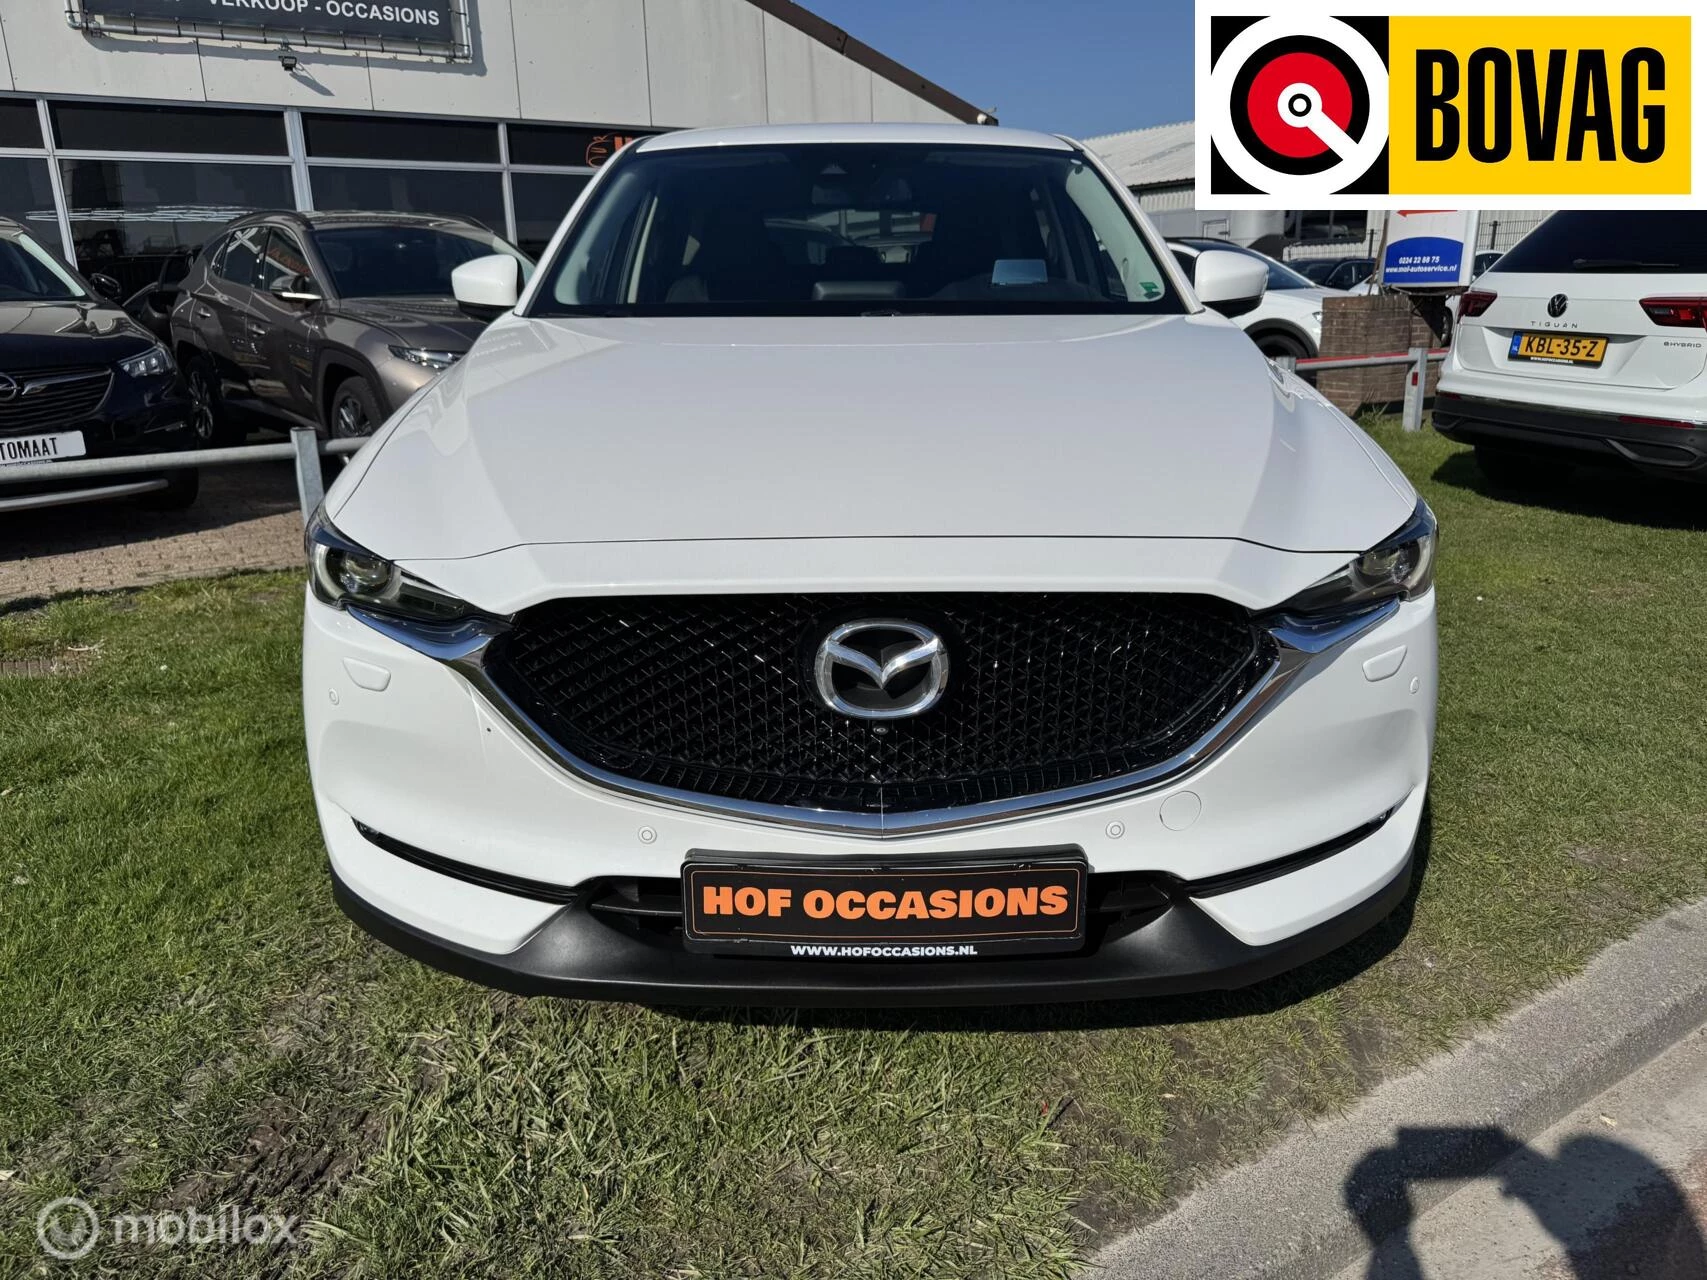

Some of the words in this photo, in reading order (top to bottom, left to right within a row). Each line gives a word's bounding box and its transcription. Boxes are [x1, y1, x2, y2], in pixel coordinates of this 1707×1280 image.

[327, 0, 440, 25] OCCASIONS
[1530, 320, 1578, 329] TIGUAN
[1524, 336, 1599, 357] KBL-35-Z
[0, 437, 58, 461] TOMAAT
[703, 886, 792, 917] HOF
[803, 885, 1069, 920] OCCASIONS
[790, 945, 978, 957] WWW.HOFOCCASIONS.NL
